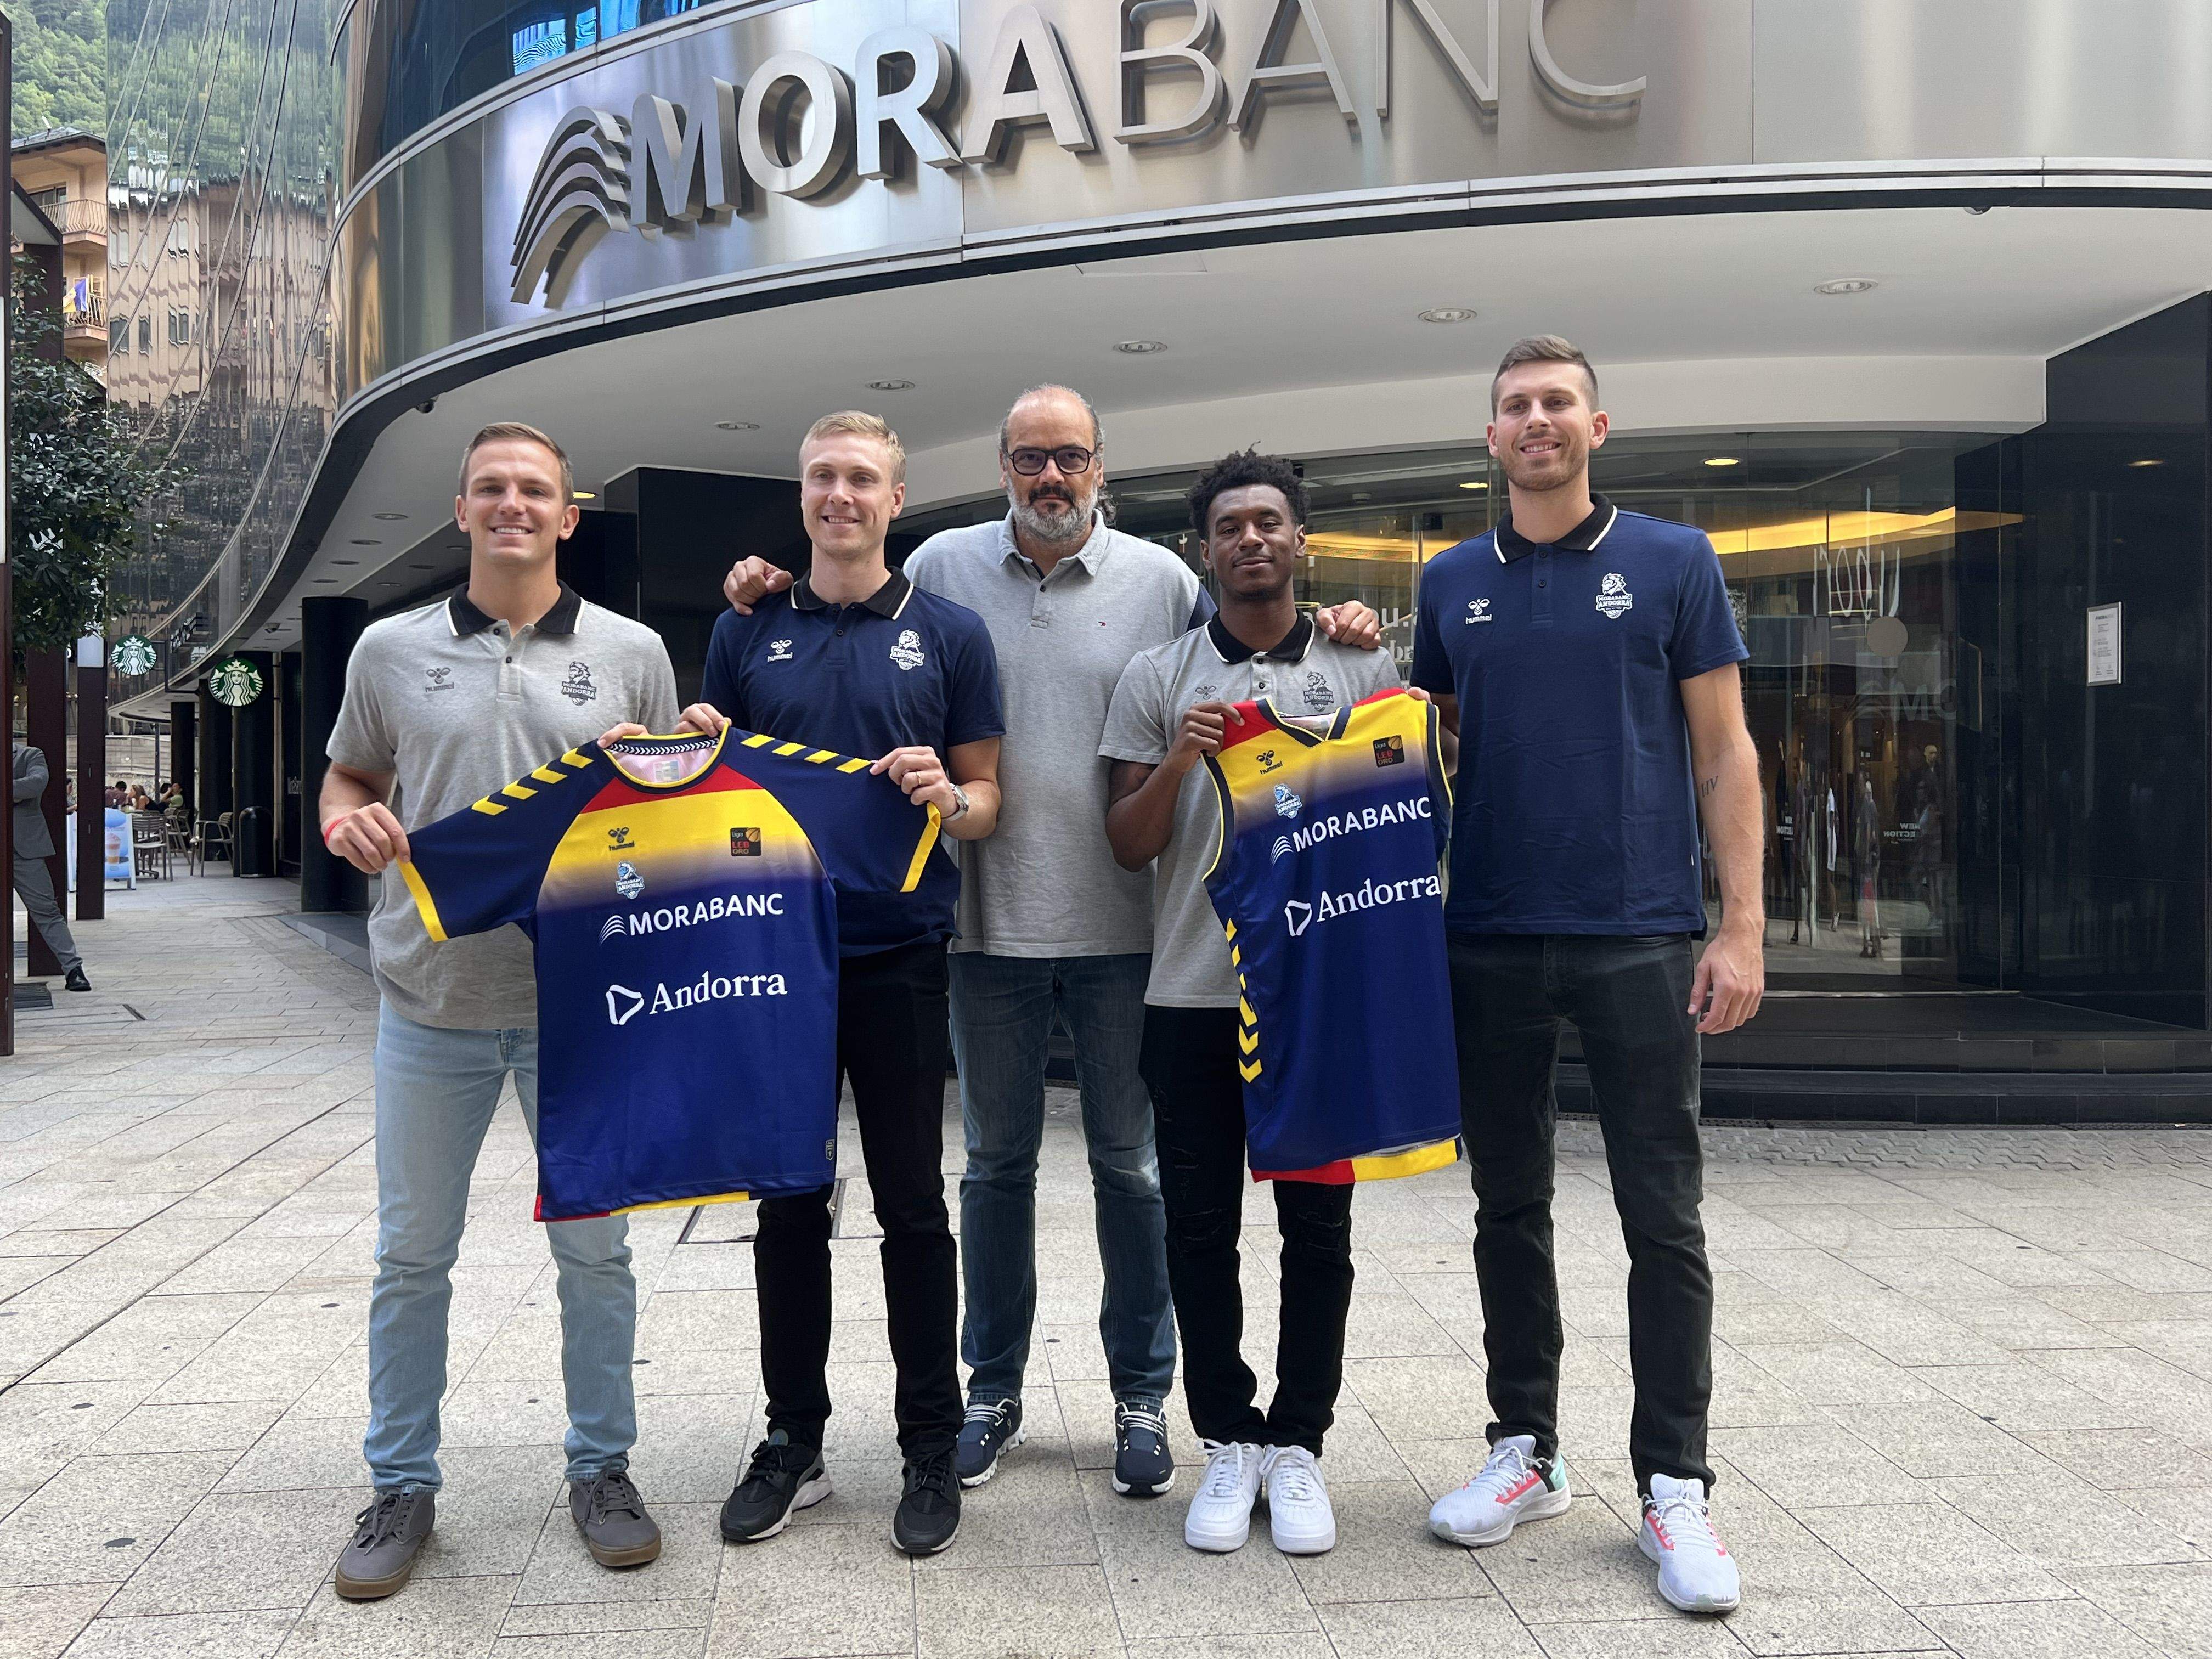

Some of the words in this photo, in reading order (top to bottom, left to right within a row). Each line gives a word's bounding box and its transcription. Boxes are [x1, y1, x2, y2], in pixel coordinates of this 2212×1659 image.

[631, 0, 1647, 229] MORABANC
[1598, 599, 1631, 609] ANDORRA
[1465, 613, 1492, 625] hummel
[767, 652, 793, 662] hummel
[425, 681, 455, 692] hummel
[1376, 750, 1393, 759] LEB
[1378, 757, 1393, 765] ORO
[1260, 760, 1283, 775] hummel
[1293, 797, 1431, 852] MORABANC
[608, 840, 635, 851] hummel
[731, 840, 750, 849] LEB
[1317, 875, 1441, 923] Andorra
[629, 893, 783, 936] MORABANC
[649, 970, 788, 1014] Andorra
